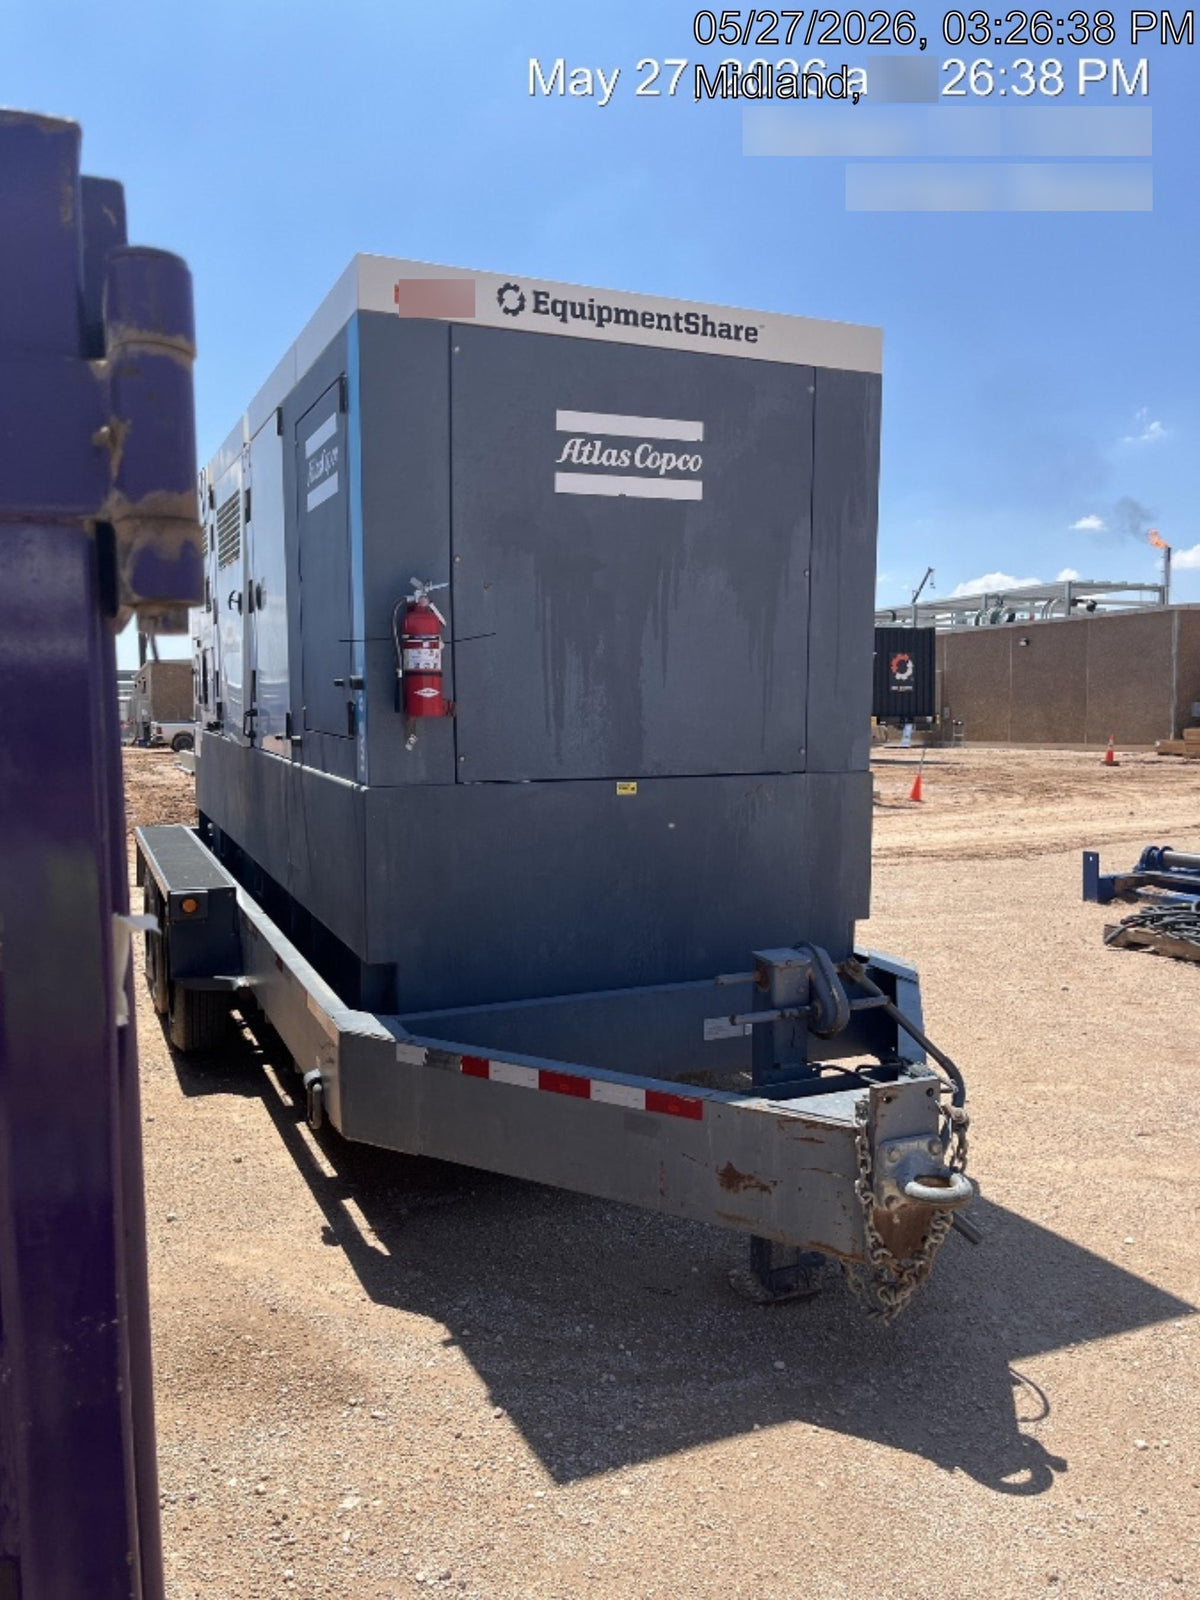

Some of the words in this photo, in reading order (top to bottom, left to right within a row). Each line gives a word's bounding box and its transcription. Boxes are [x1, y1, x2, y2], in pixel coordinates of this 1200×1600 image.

[532, 289, 759, 344] EquipmentShare
[555, 438, 632, 467] Atlas
[634, 443, 703, 476] Copco
